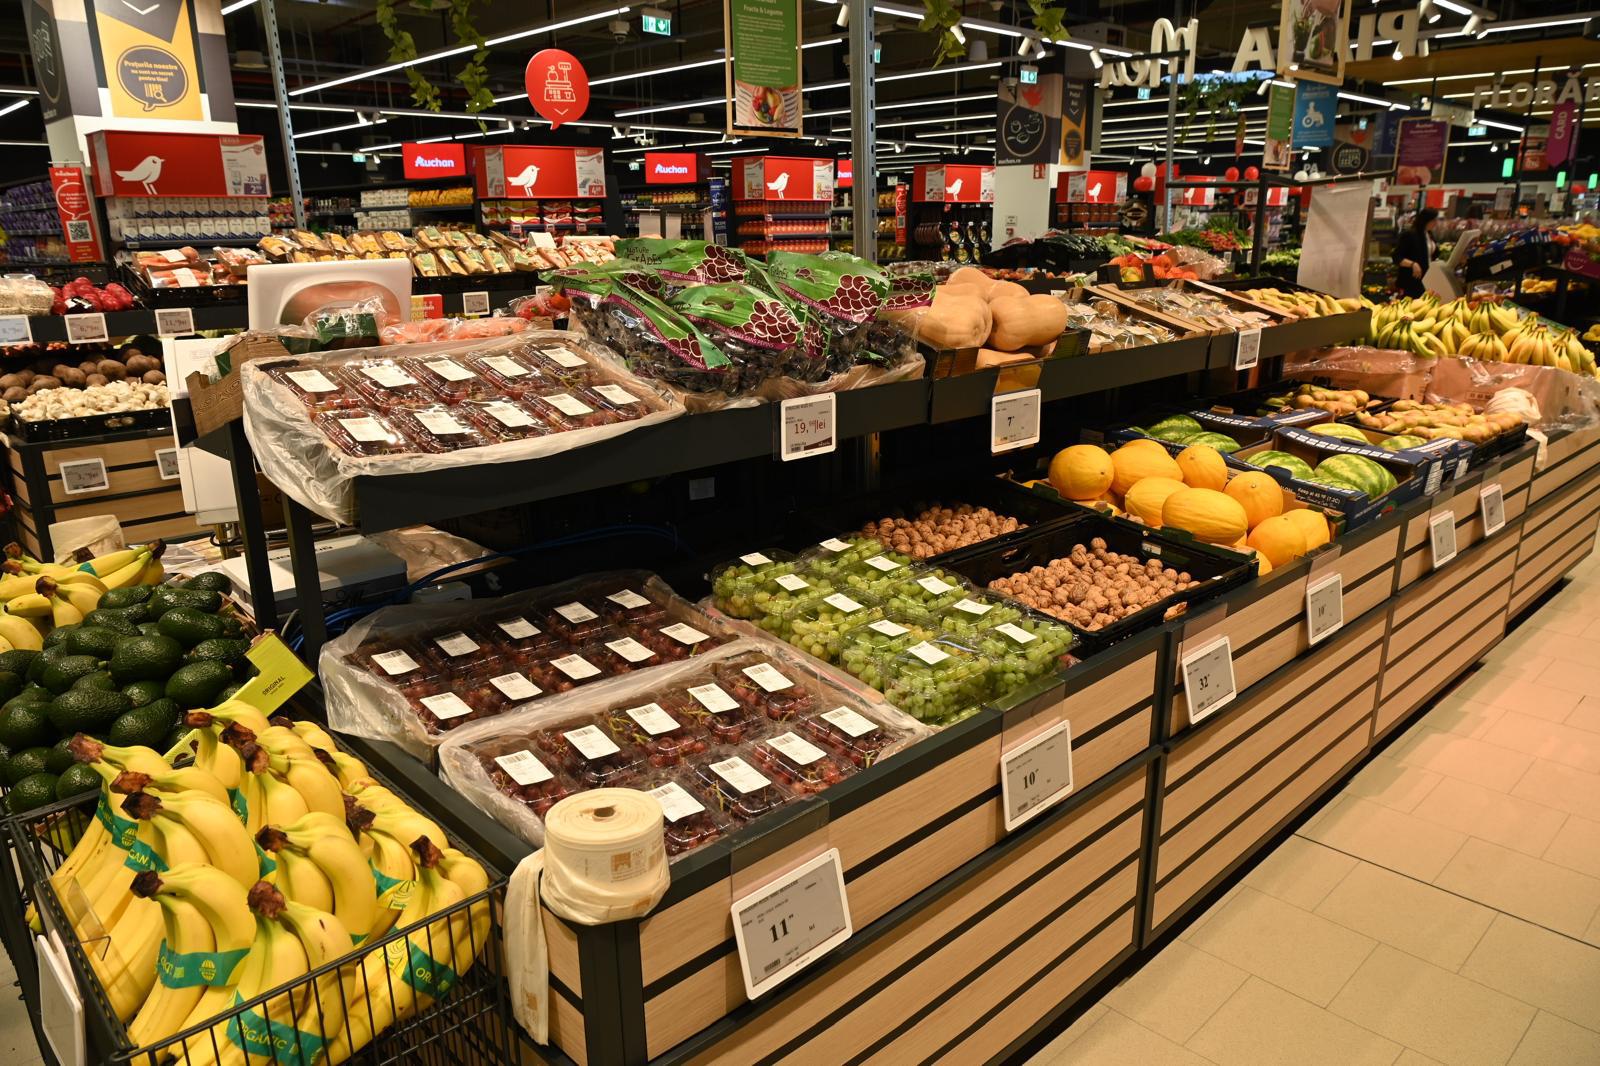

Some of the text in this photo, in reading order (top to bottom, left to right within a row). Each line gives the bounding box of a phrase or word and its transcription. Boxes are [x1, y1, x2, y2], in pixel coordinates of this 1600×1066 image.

[414, 155, 455, 169] Auchan
[655, 163, 688, 175] Auchan
[261, 675, 286, 696] ORIGINAL
